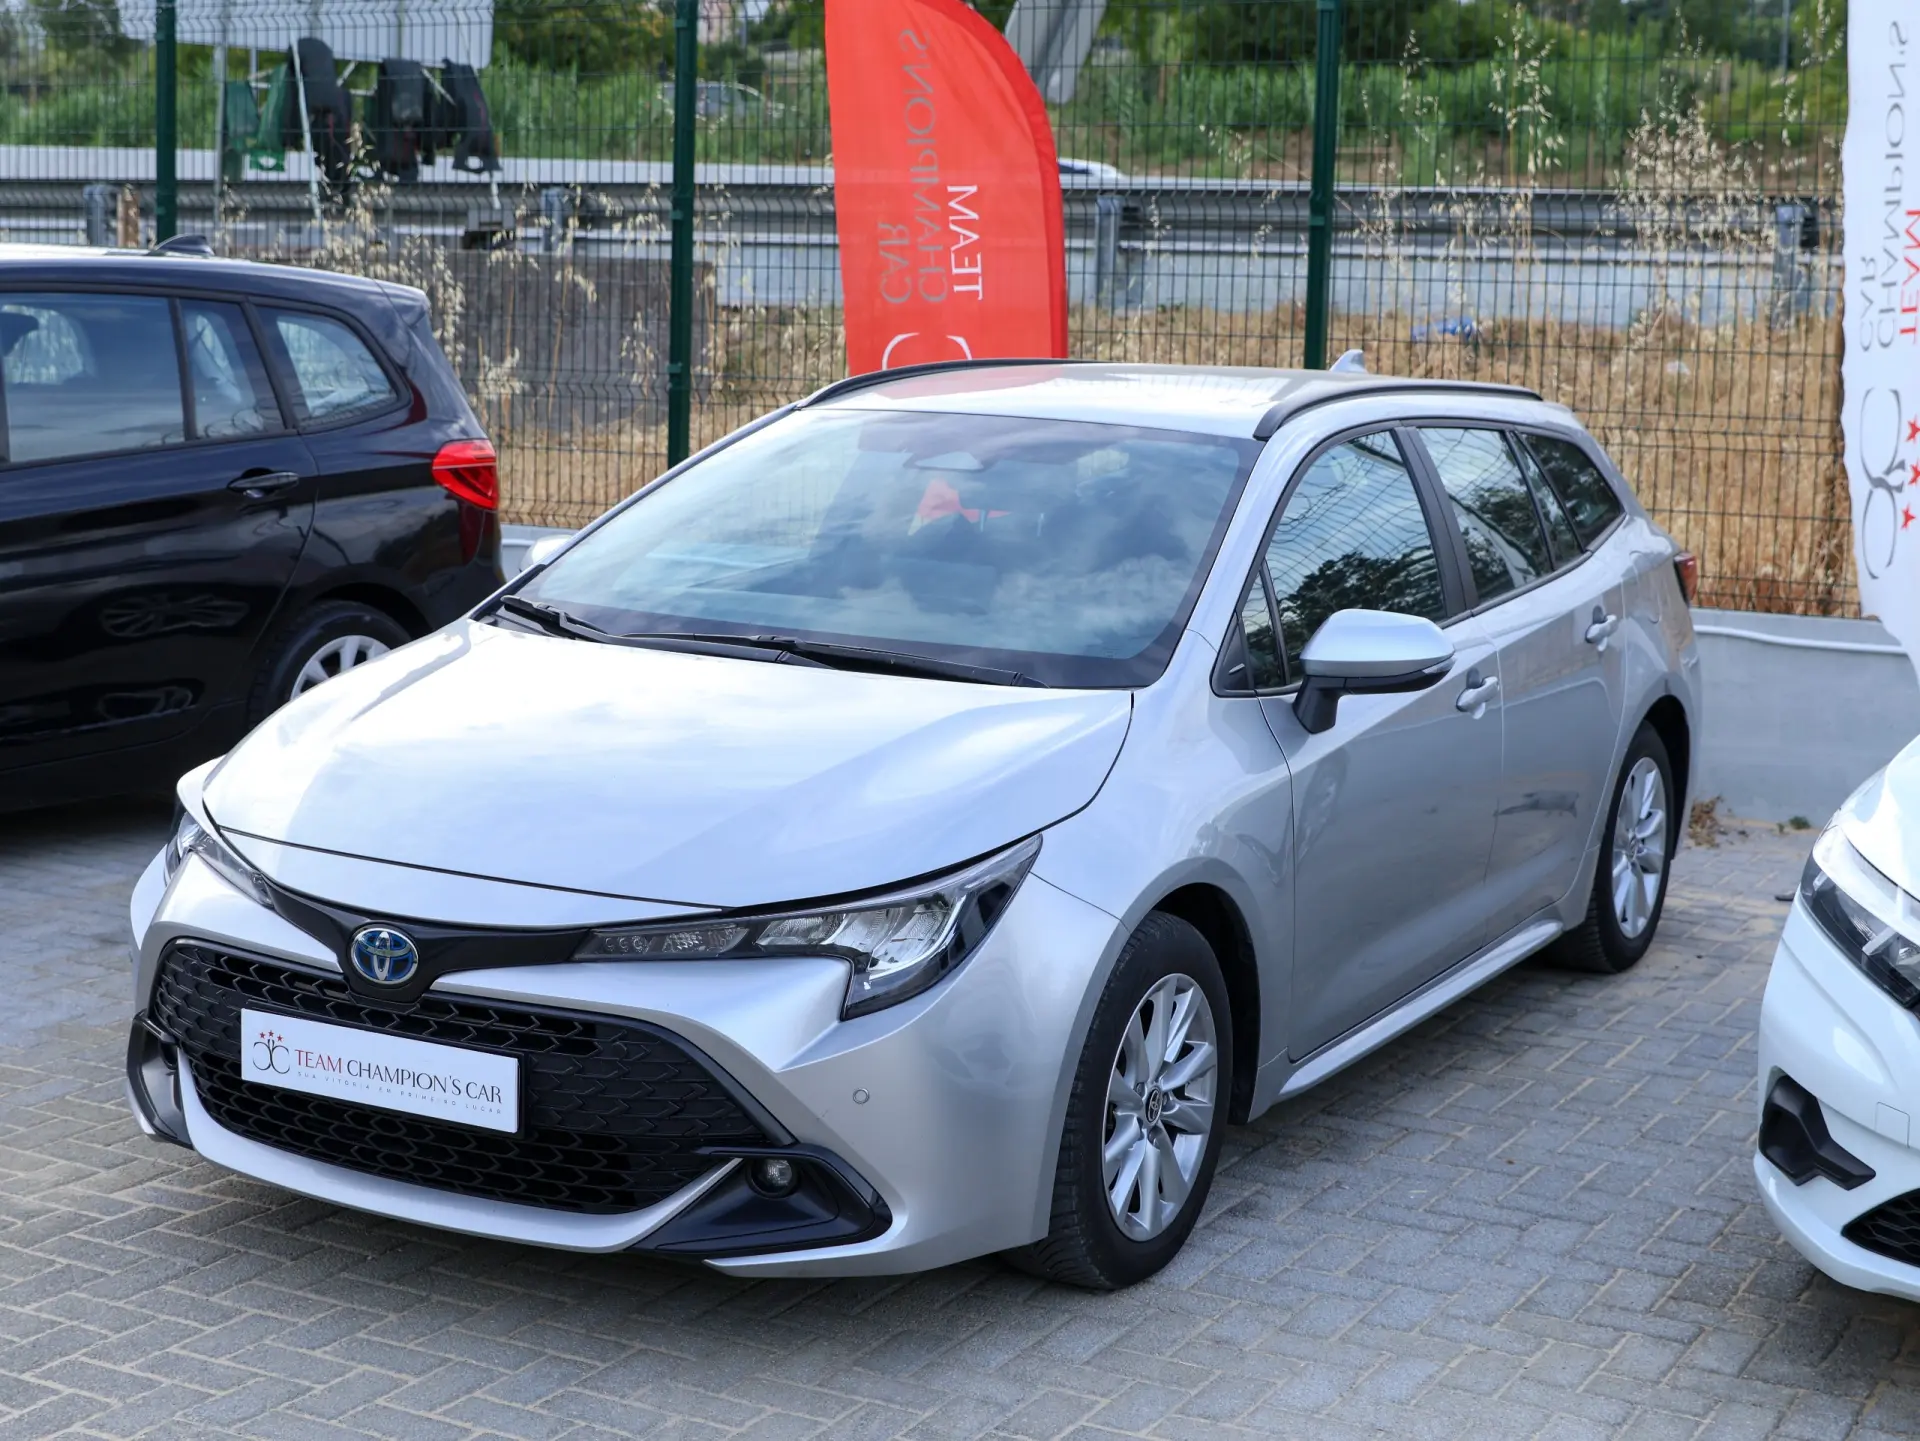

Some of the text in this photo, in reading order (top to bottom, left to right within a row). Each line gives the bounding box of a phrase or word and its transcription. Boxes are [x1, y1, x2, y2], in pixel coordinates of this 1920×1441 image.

[294, 1049, 502, 1104] TEAM CHAMPION'S CAR
[297, 1071, 316, 1079] SUA
